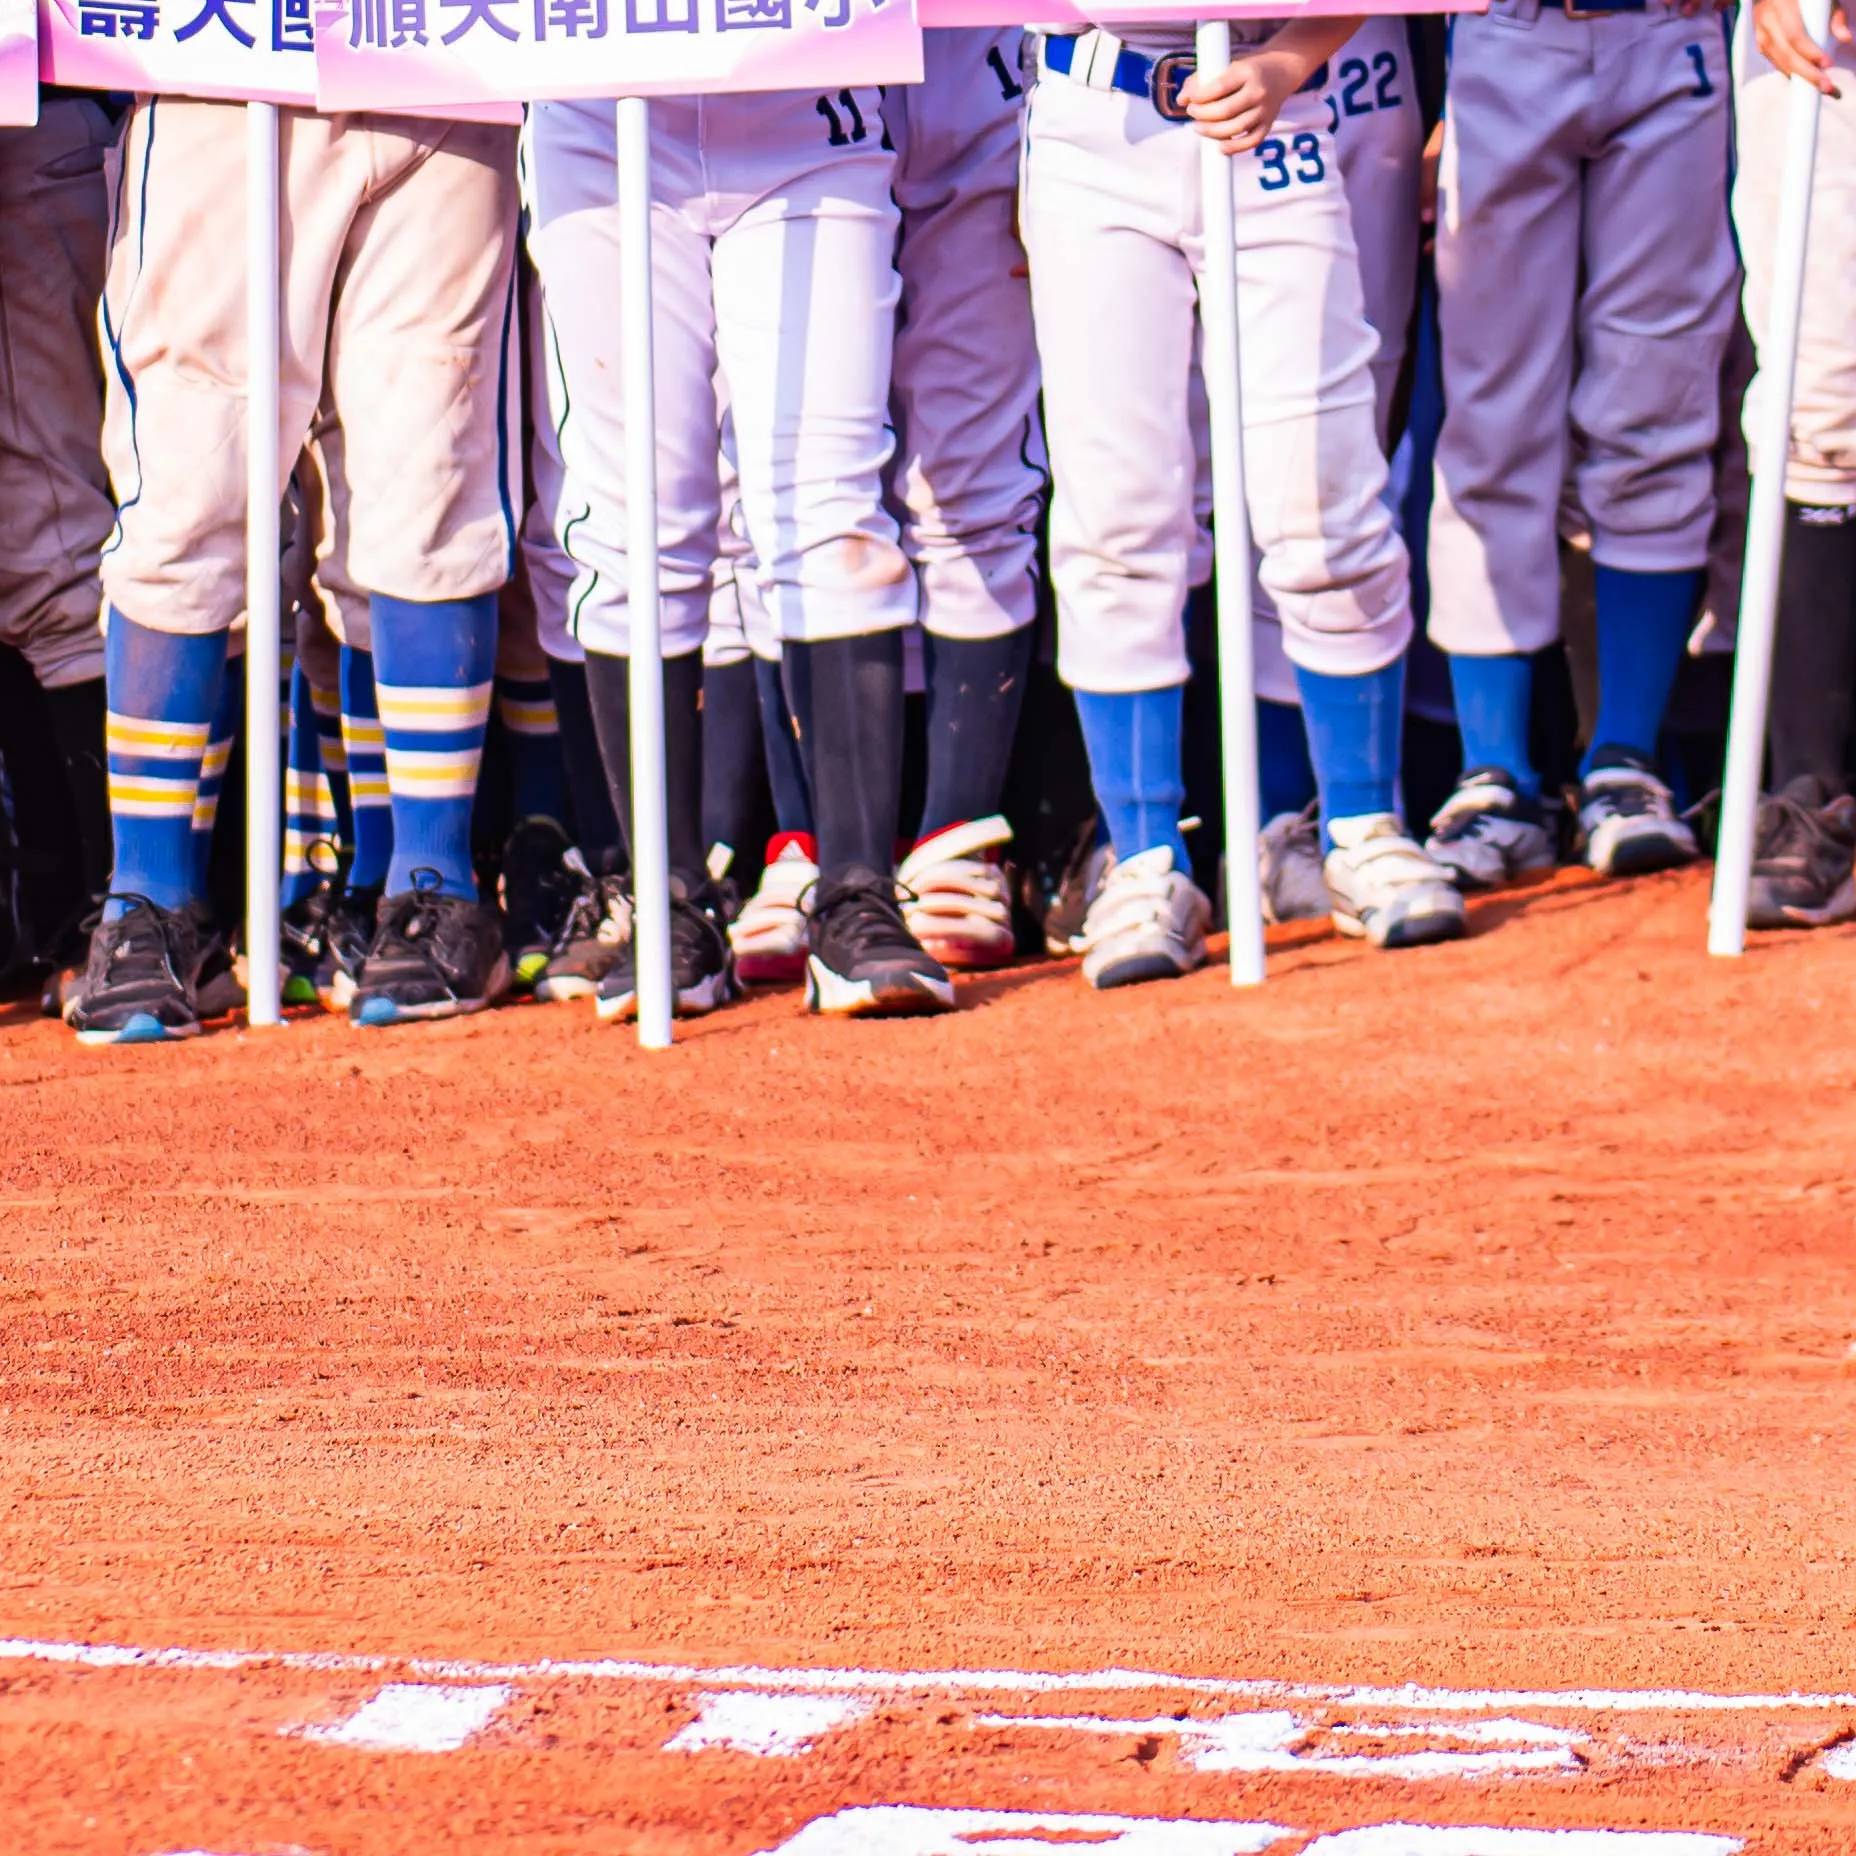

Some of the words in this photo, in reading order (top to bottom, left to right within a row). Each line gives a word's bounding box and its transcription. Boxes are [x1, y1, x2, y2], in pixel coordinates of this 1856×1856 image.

[1338, 50, 1403, 116] 22
[816, 89, 868, 146] 11
[1253, 132, 1327, 191] 33
